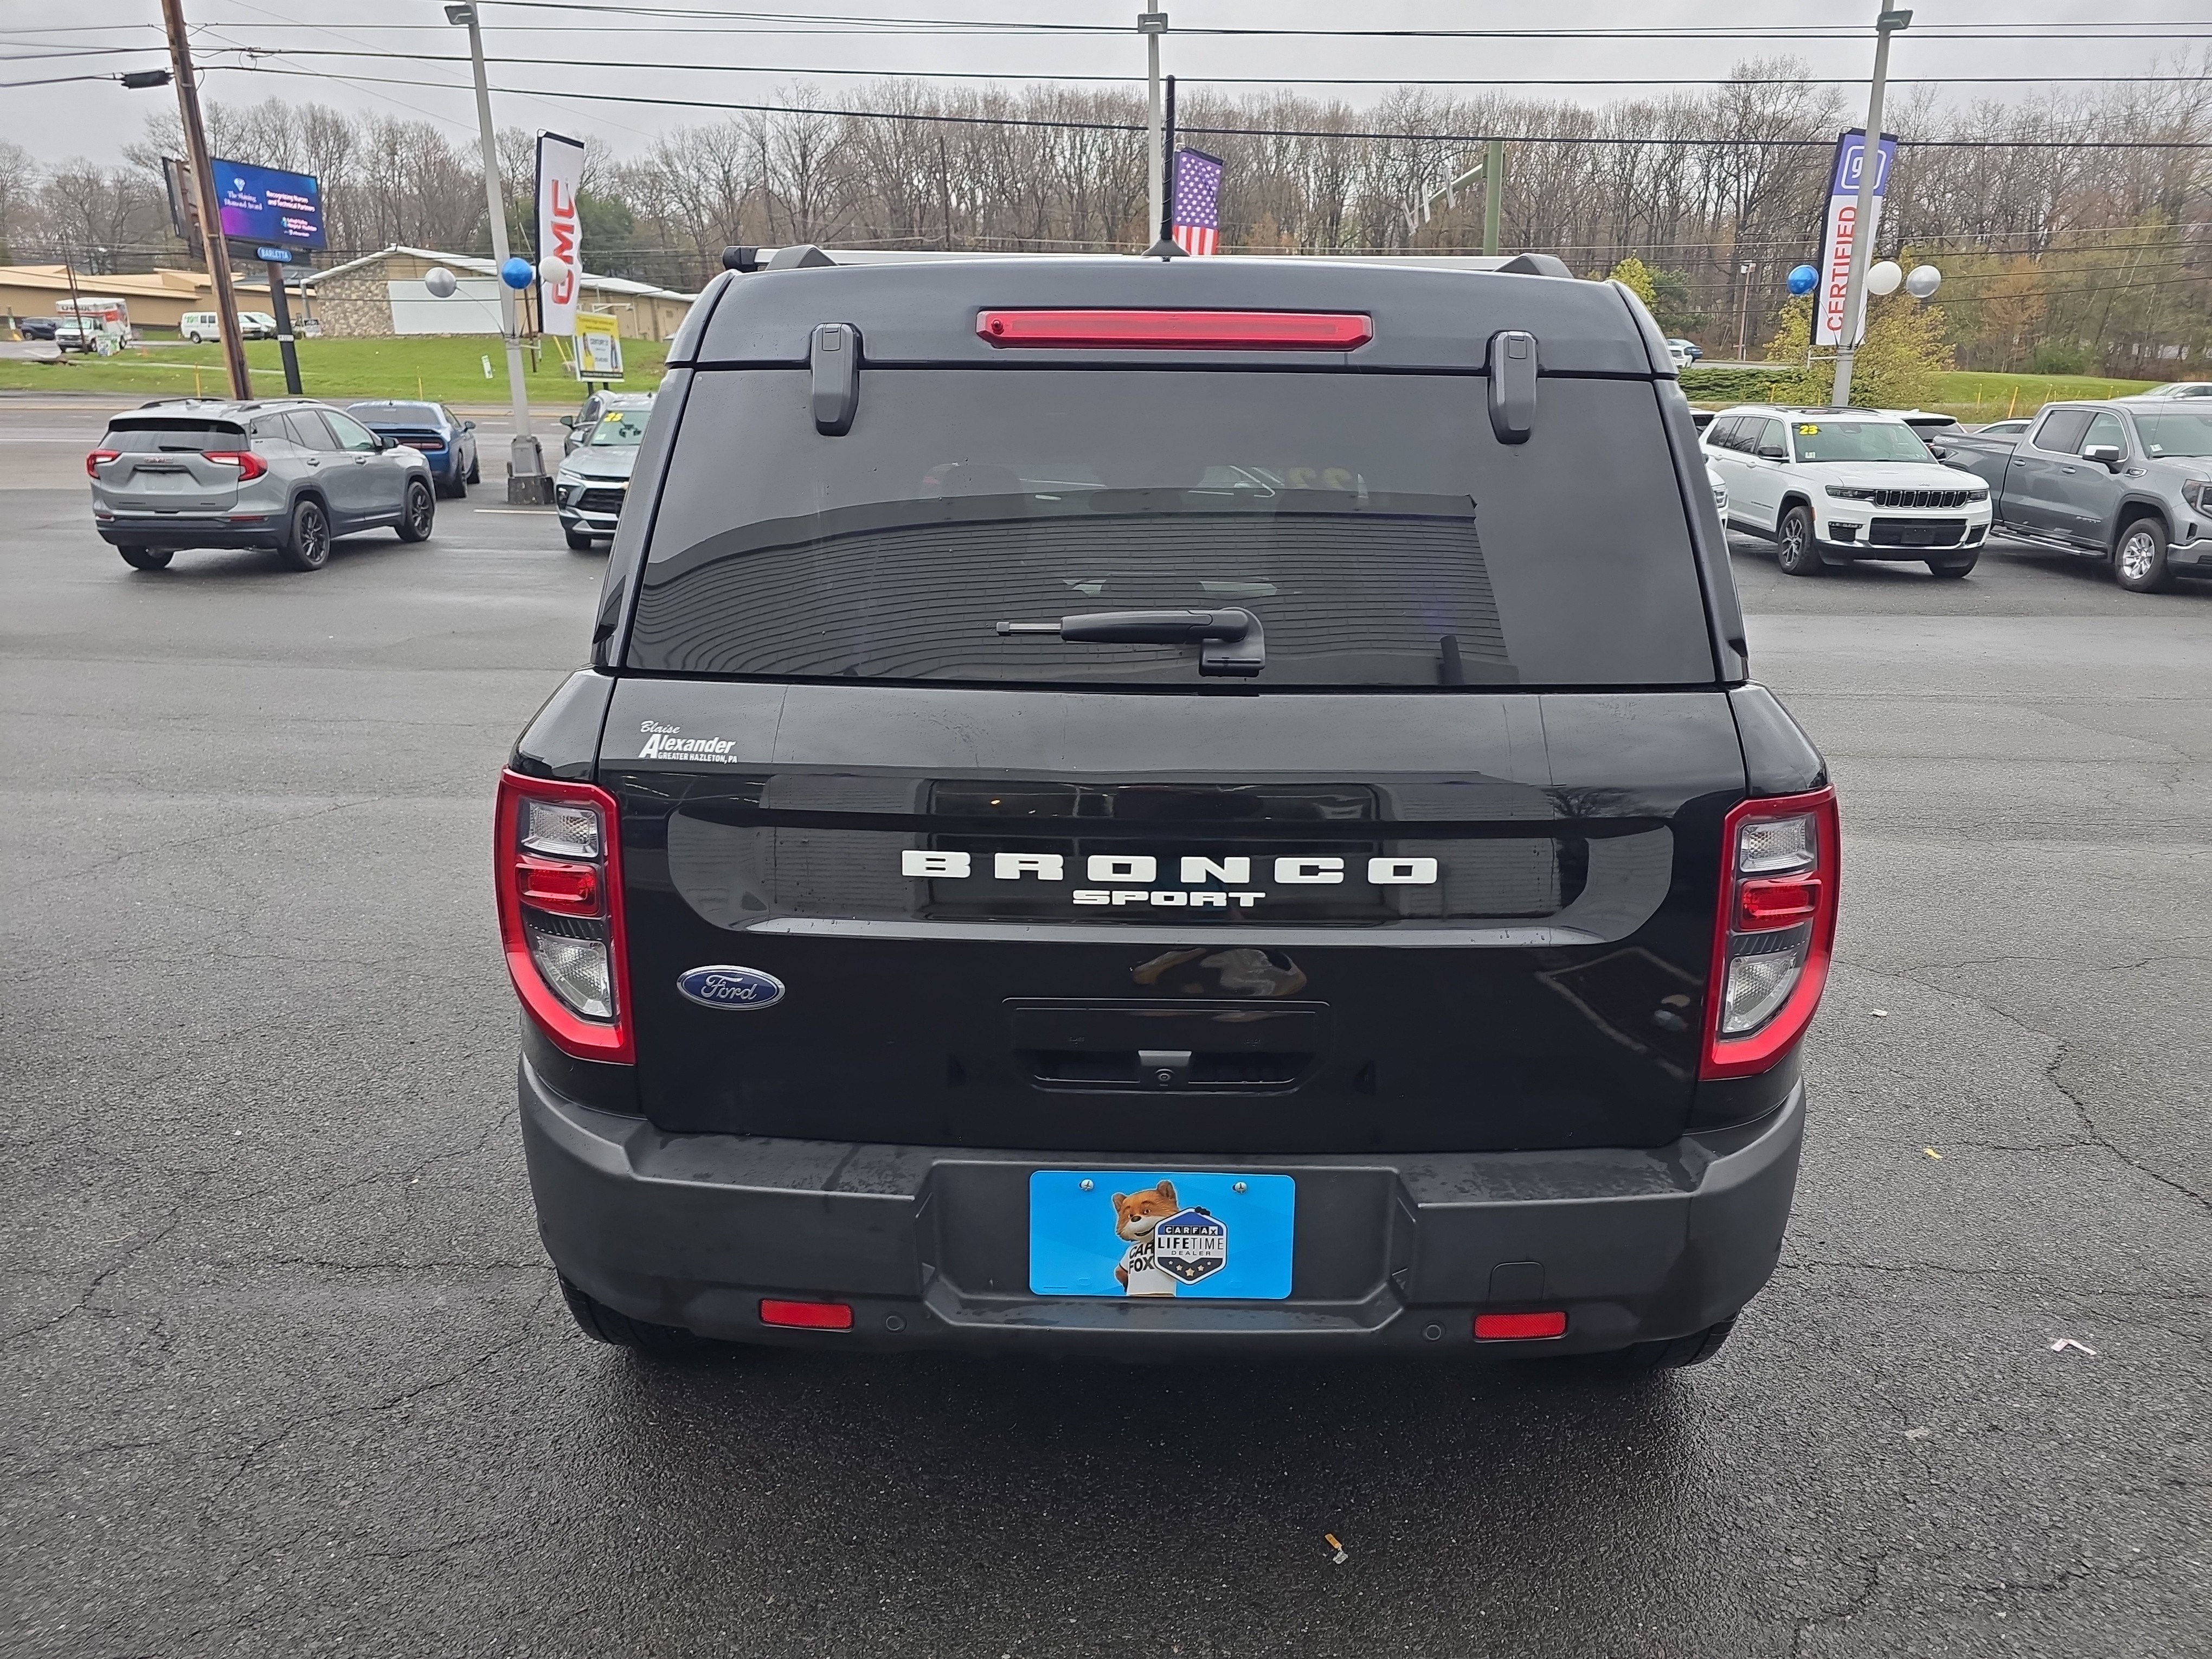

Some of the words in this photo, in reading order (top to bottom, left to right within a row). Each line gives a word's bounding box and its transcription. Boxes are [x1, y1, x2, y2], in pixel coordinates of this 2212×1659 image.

[1827, 205, 1858, 331] CERTIFIED
[1799, 425, 1818, 435] 23
[640, 720, 681, 734] Blaise
[638, 734, 737, 758] Alexander
[658, 751, 689, 761] GREATER
[728, 755, 738, 763] PA
[902, 850, 1438, 884] BRONCO
[1072, 890, 1266, 906] SPORT
[700, 974, 758, 1000] Ford
[1165, 1226, 1217, 1235] CARFAX
[1158, 1237, 1224, 1250] LIFETIME
[1129, 1256, 1155, 1274] FOX
